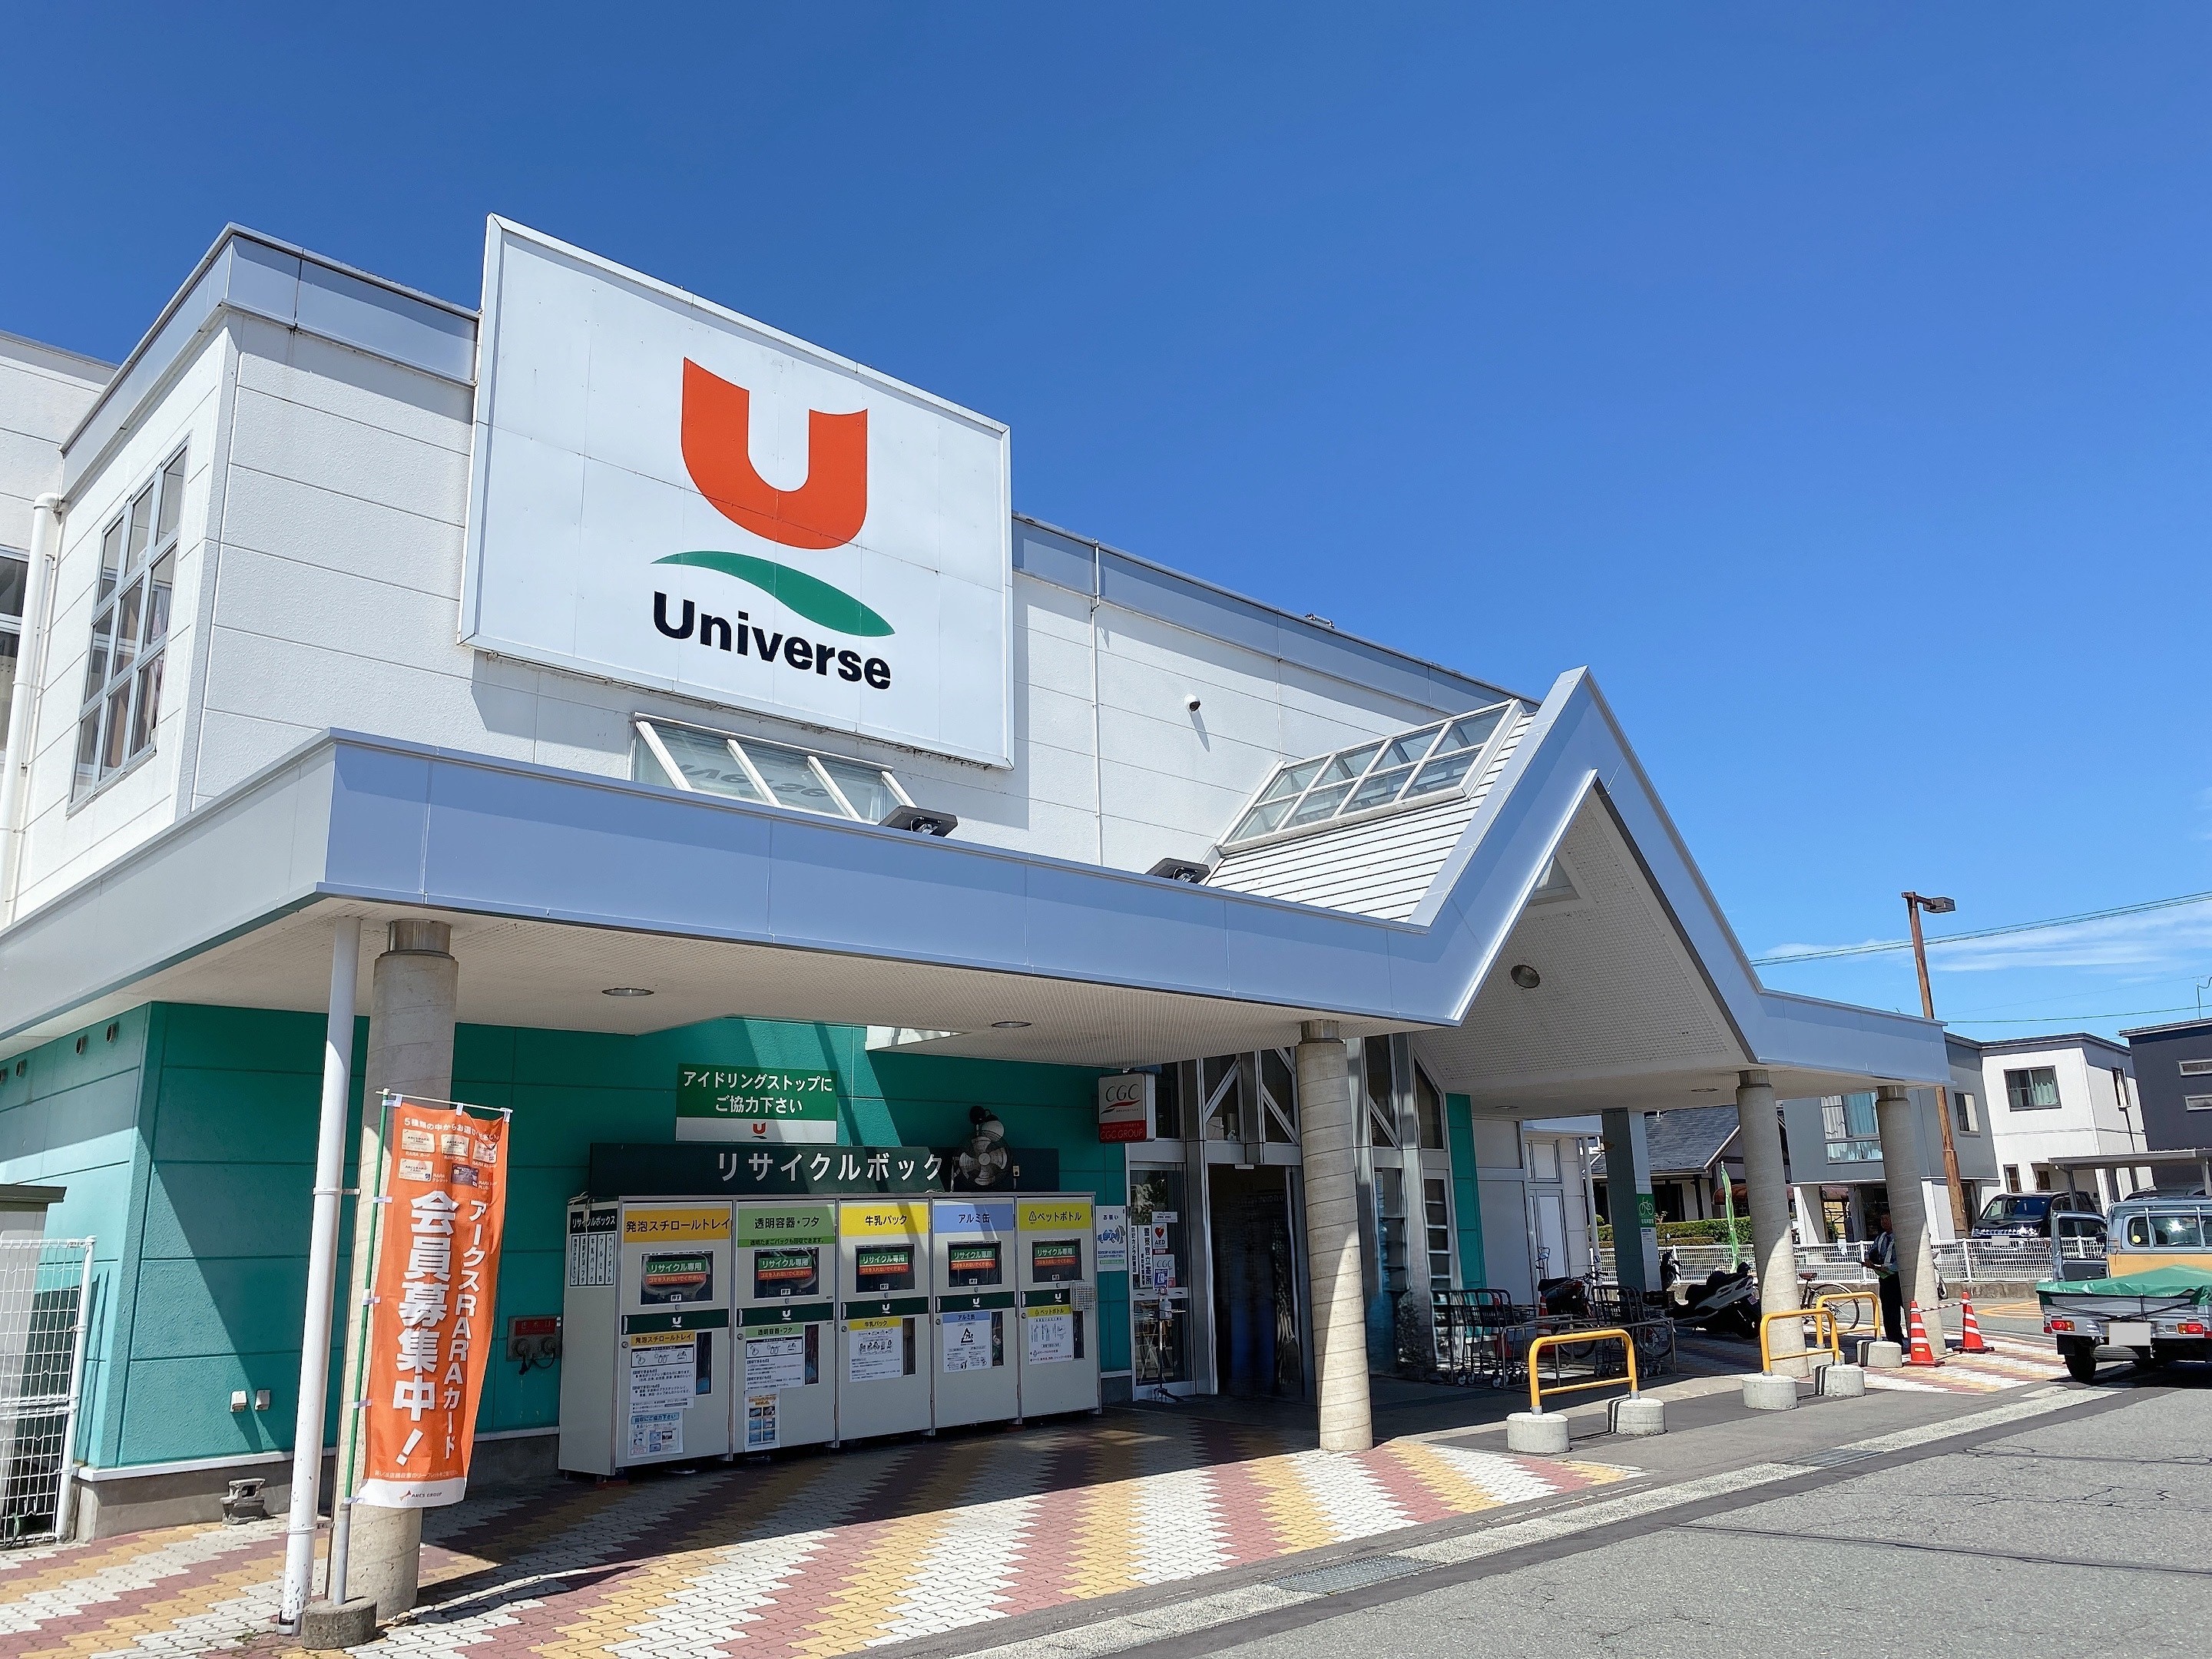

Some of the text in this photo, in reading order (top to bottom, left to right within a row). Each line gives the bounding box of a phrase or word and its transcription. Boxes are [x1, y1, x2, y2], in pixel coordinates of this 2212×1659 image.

[653, 591, 891, 690] Universe
[683, 1071, 833, 1092] アイドリングストップに
[1106, 1084, 1139, 1101] CGC
[715, 1096, 803, 1114] ご協力下さい
[1100, 1128, 1143, 1139] CGC GROUP
[865, 1214, 907, 1226] 牛乳パック
[958, 1214, 990, 1224] アルミ缶
[1038, 1211, 1081, 1222] ペットボトル
[626, 1217, 730, 1233] 発泡スチロールトレイ
[754, 1216, 820, 1230] 透明容器・フタ
[954, 1250, 992, 1260] リサイクル専用
[1037, 1248, 1073, 1257] リサイクル専用
[762, 1259, 809, 1268] リサイクル専用
[863, 1254, 905, 1263] リサイクル専用
[1157, 1260, 1173, 1268] CGC
[651, 1262, 702, 1273] リサイクル専用
[635, 1333, 691, 1344] 発泡スチロールトレイ
